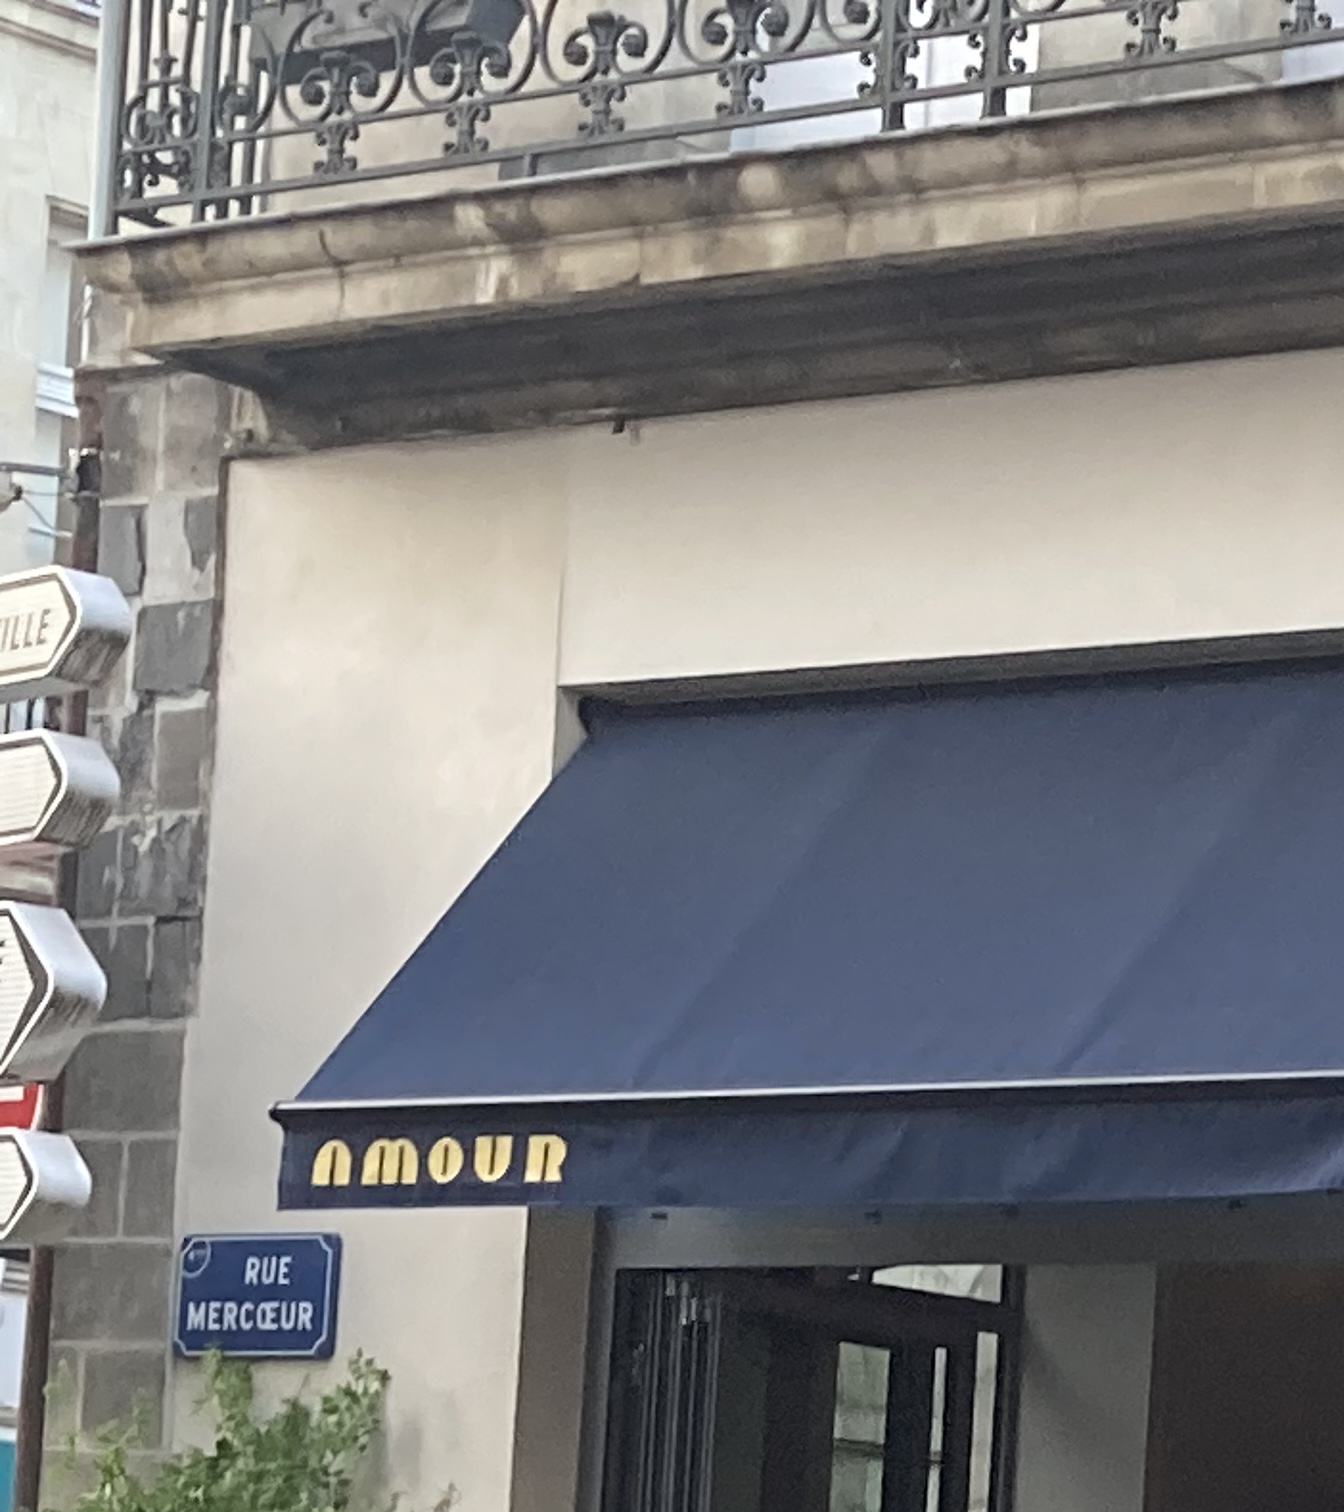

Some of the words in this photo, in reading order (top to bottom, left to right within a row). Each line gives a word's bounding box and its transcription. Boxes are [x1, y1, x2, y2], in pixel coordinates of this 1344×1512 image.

[0, 608, 52, 652] ILLE
[311, 1134, 567, 1187] AMOUR
[244, 1255, 292, 1286] RUE
[186, 1300, 314, 1331] MERCŒUR
